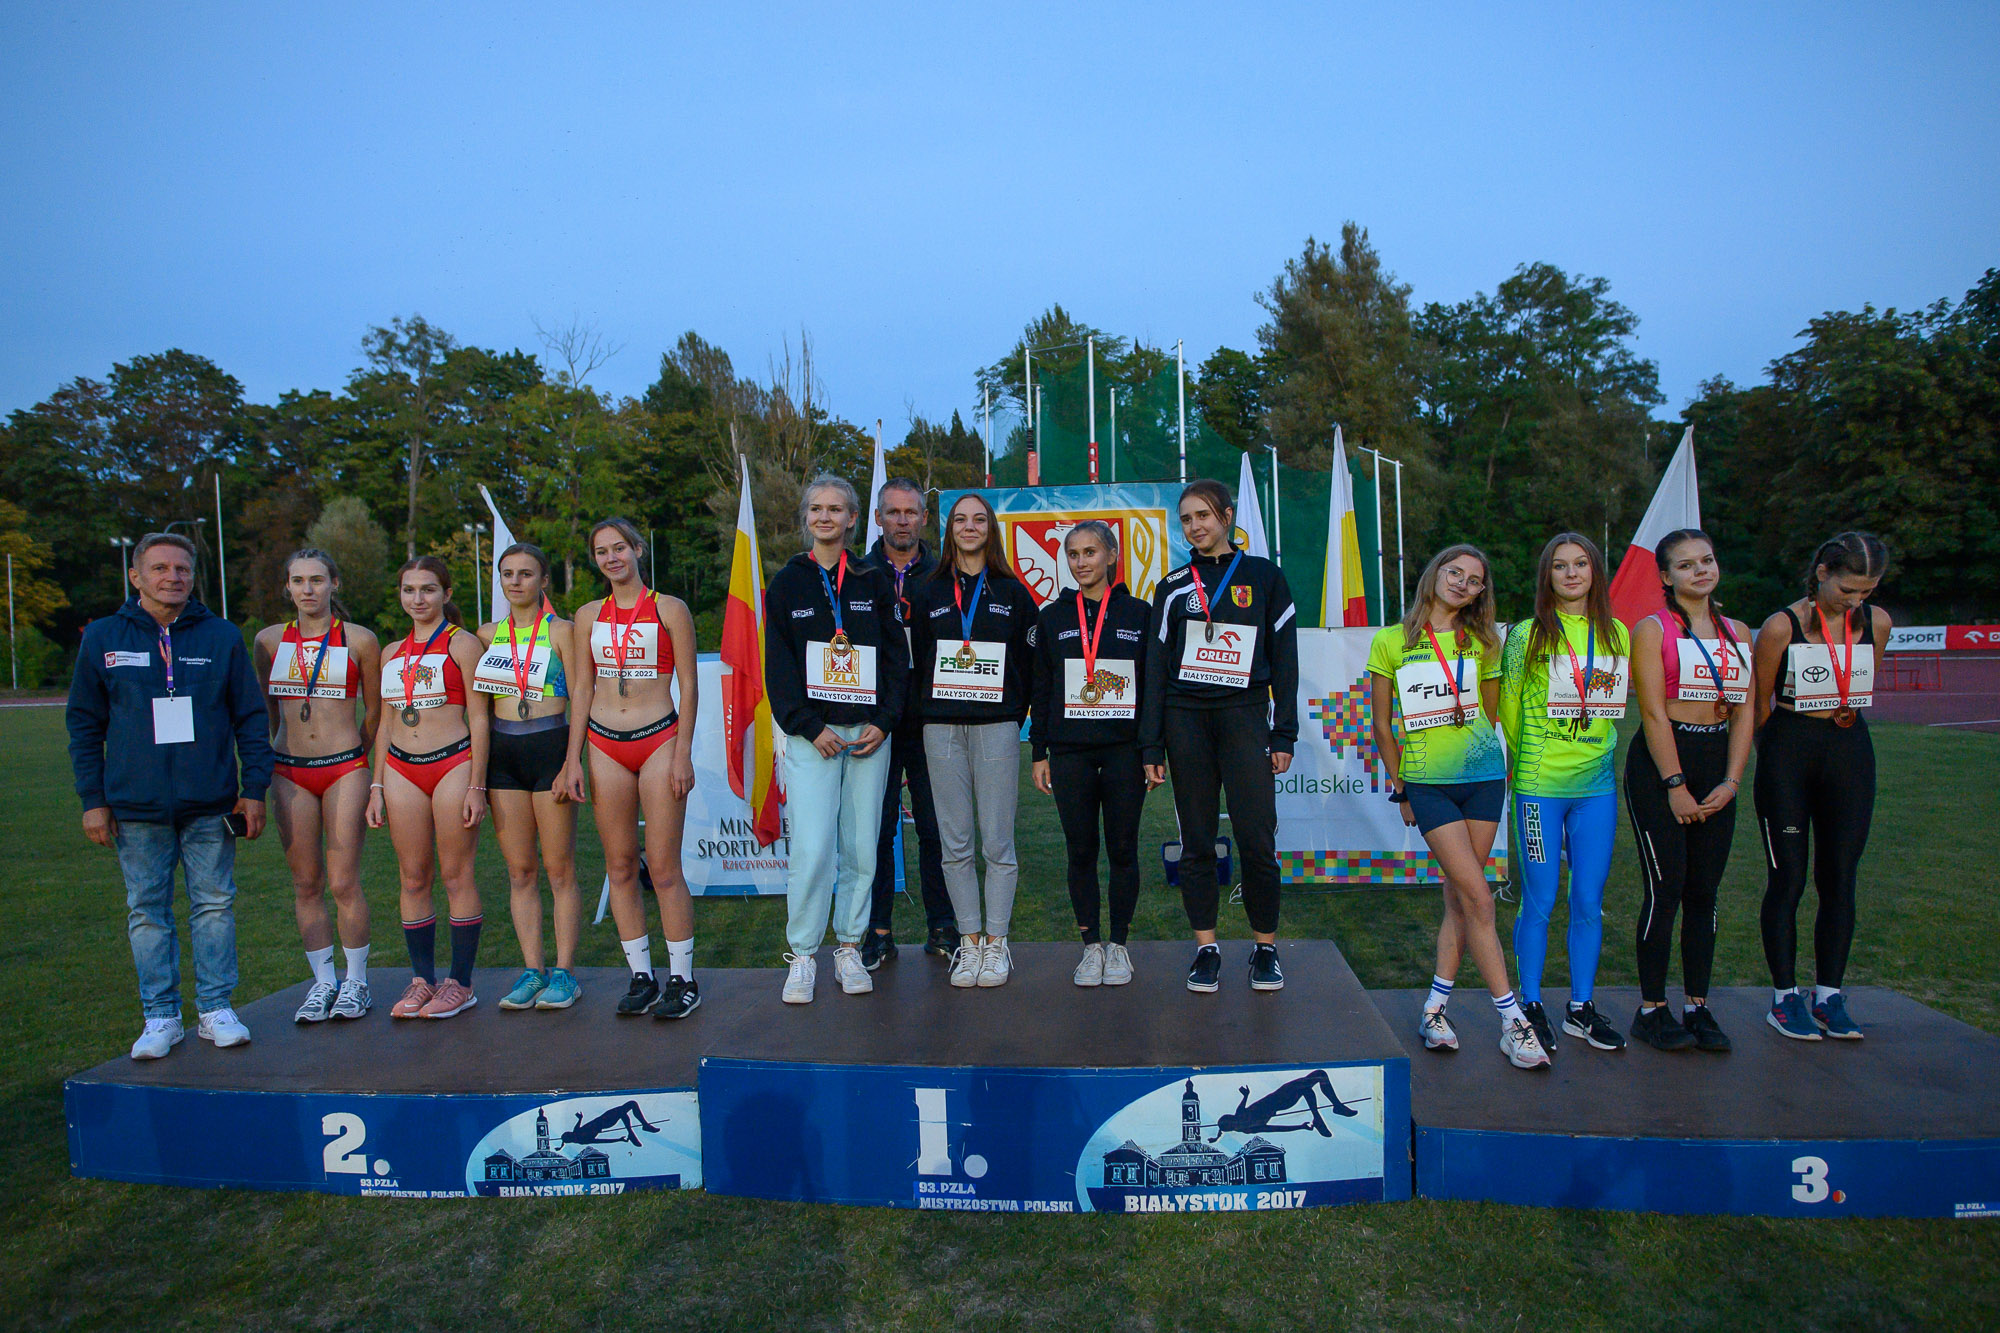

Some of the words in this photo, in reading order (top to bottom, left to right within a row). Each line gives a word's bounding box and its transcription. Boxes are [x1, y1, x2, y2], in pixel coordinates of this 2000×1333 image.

[1898, 633, 1943, 643] SPORT
[1199, 651, 1238, 663] ORLEN
[825, 672, 857, 684] PZLA
[1184, 672, 1223, 682] BIAŁYSTOK
[1226, 677, 1244, 685] 2022
[477, 683, 519, 695] BIAŁYSTOK
[524, 690, 538, 699] 022
[811, 691, 852, 701] BIAŁYSTOK
[854, 695, 872, 703] 2022
[937, 690, 977, 698] BIAŁYSTOK
[1682, 691, 1718, 699] BIAŁYSTO
[1800, 700, 1839, 709] BIAŁYSTO
[1848, 698, 1867, 706] 2022
[1678, 723, 1717, 733] NIKE
[1275, 774, 1364, 793] odlaskie
[322, 1112, 391, 1176] 2.
[500, 1184, 584, 1197] BIAŁYSTOK
[590, 1183, 625, 1195] 2017
[919, 1197, 1019, 1211] MISTRZOSTWA
[1024, 1200, 1074, 1212] POLSKI
[1124, 1192, 1248, 1212] BIAŁYSTOK
[1257, 1190, 1306, 1209] 2017
